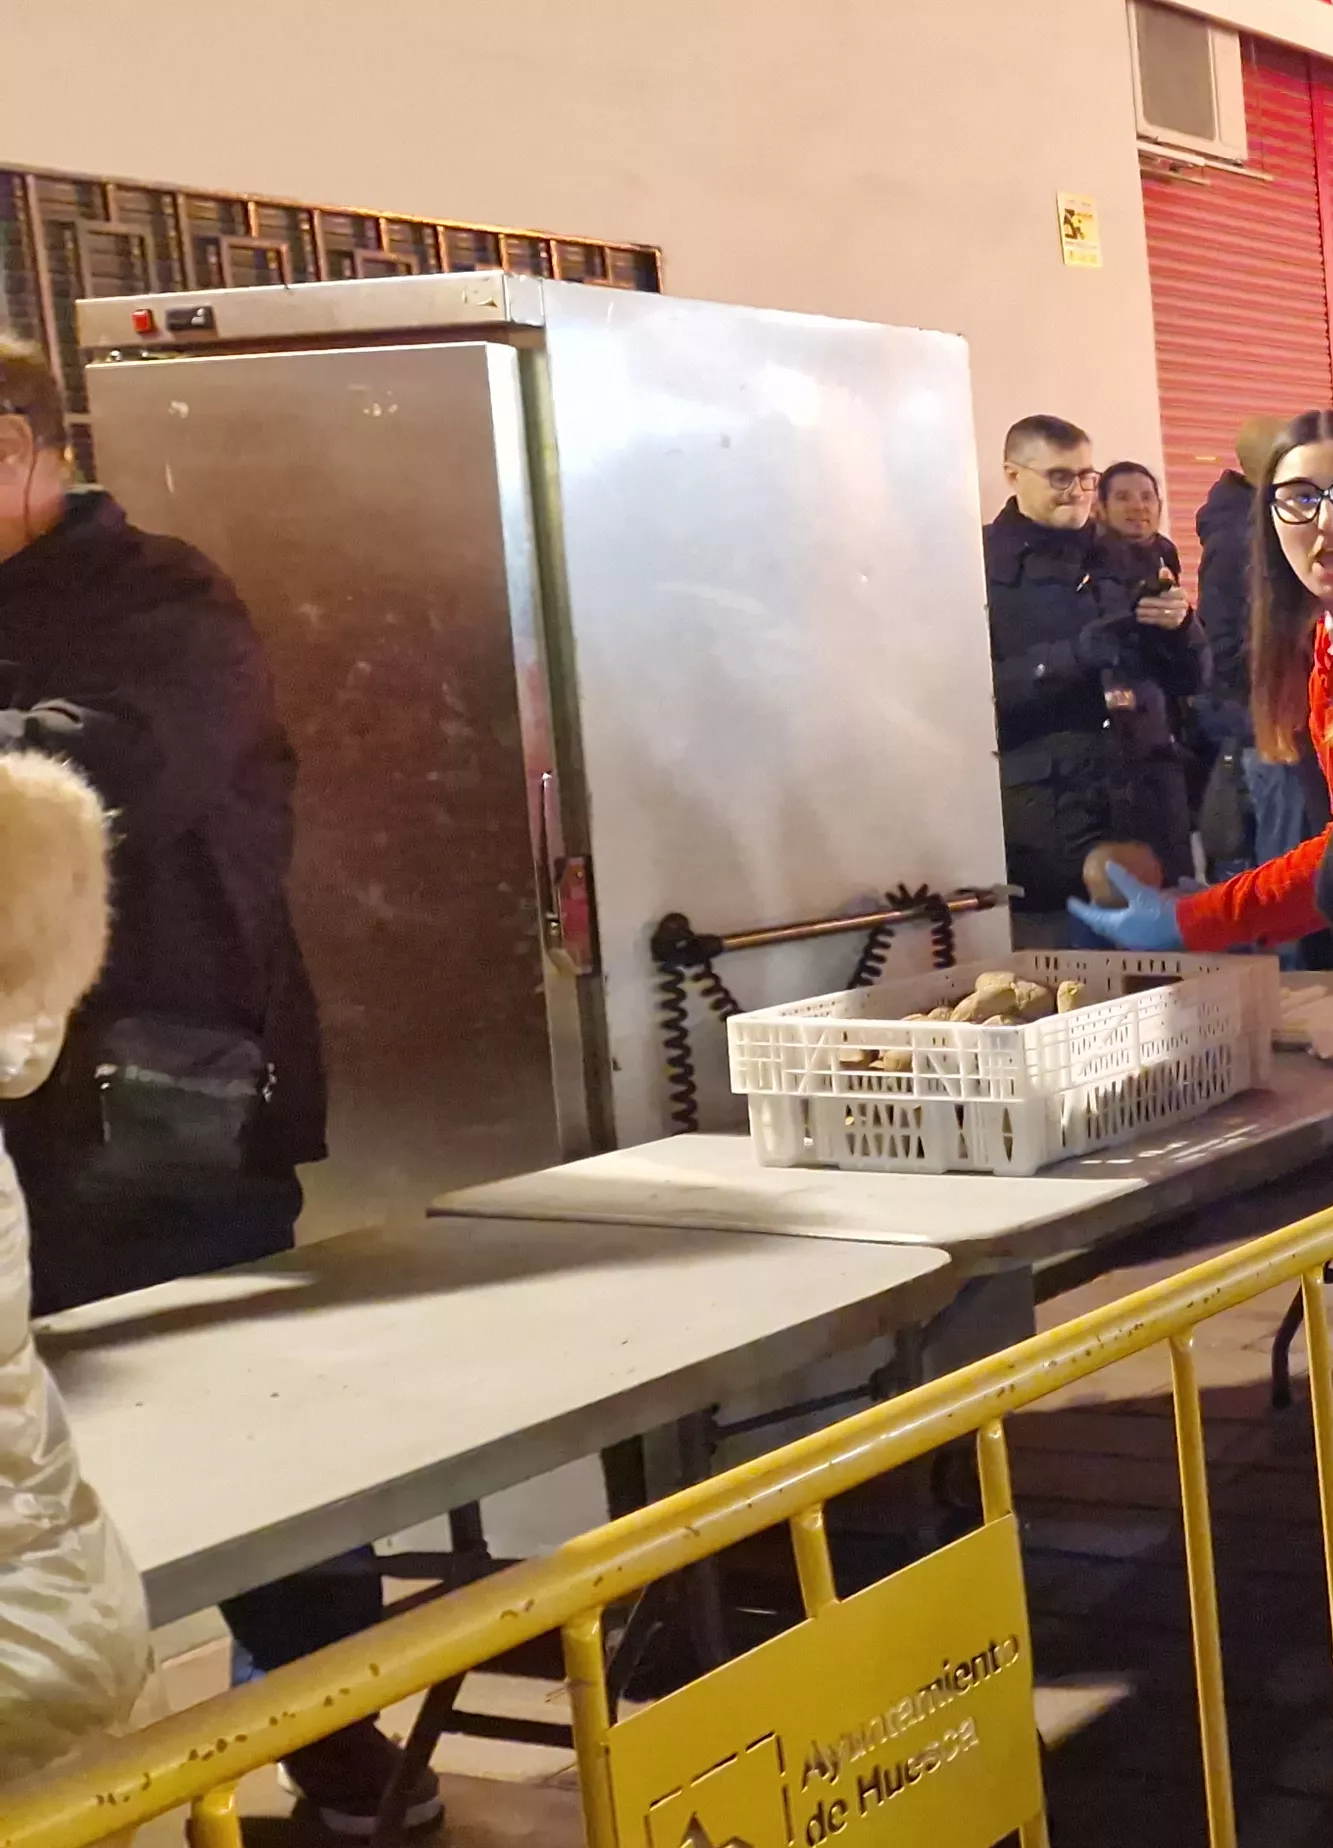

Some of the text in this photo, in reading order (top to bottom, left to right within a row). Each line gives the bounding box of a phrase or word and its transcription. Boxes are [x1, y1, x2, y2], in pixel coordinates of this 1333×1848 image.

[801, 1634, 1019, 1793] Ayuntamiento
[806, 1716, 979, 1848] de Huesca
